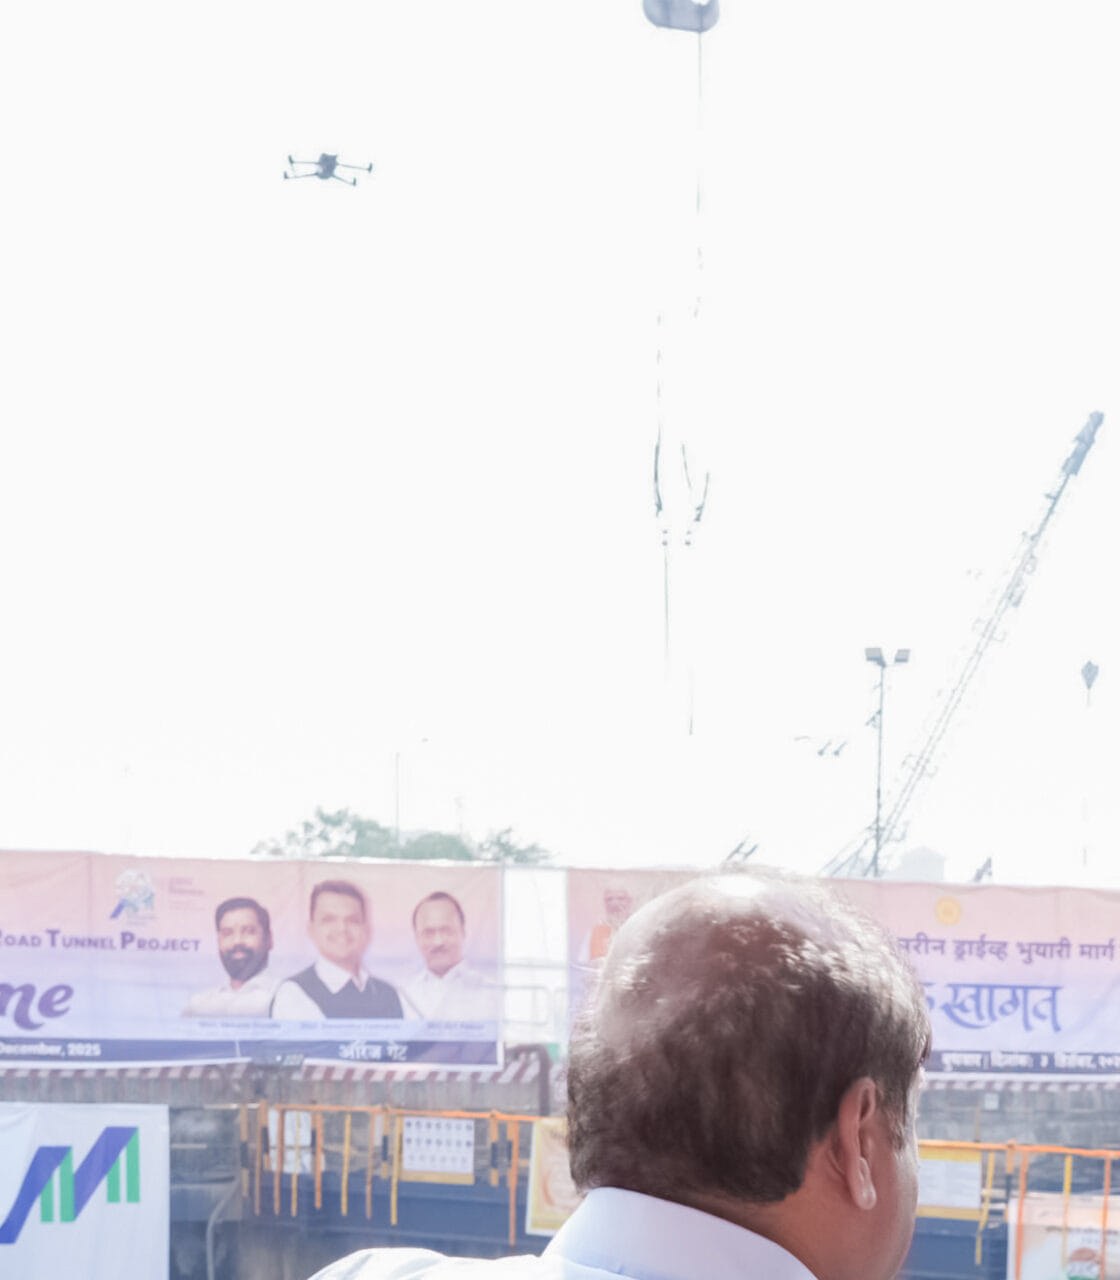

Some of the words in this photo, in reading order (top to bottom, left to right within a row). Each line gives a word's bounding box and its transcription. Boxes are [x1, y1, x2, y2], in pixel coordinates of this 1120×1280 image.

[0, 929, 42, 947] OAD
[45, 929, 116, 949] TUNNEL
[120, 931, 201, 952] PROJECT
[1016, 936, 1072, 965] भुयारी
[1079, 938, 1115, 961] मार्ग
[940, 983, 1063, 1032] स्वागत
